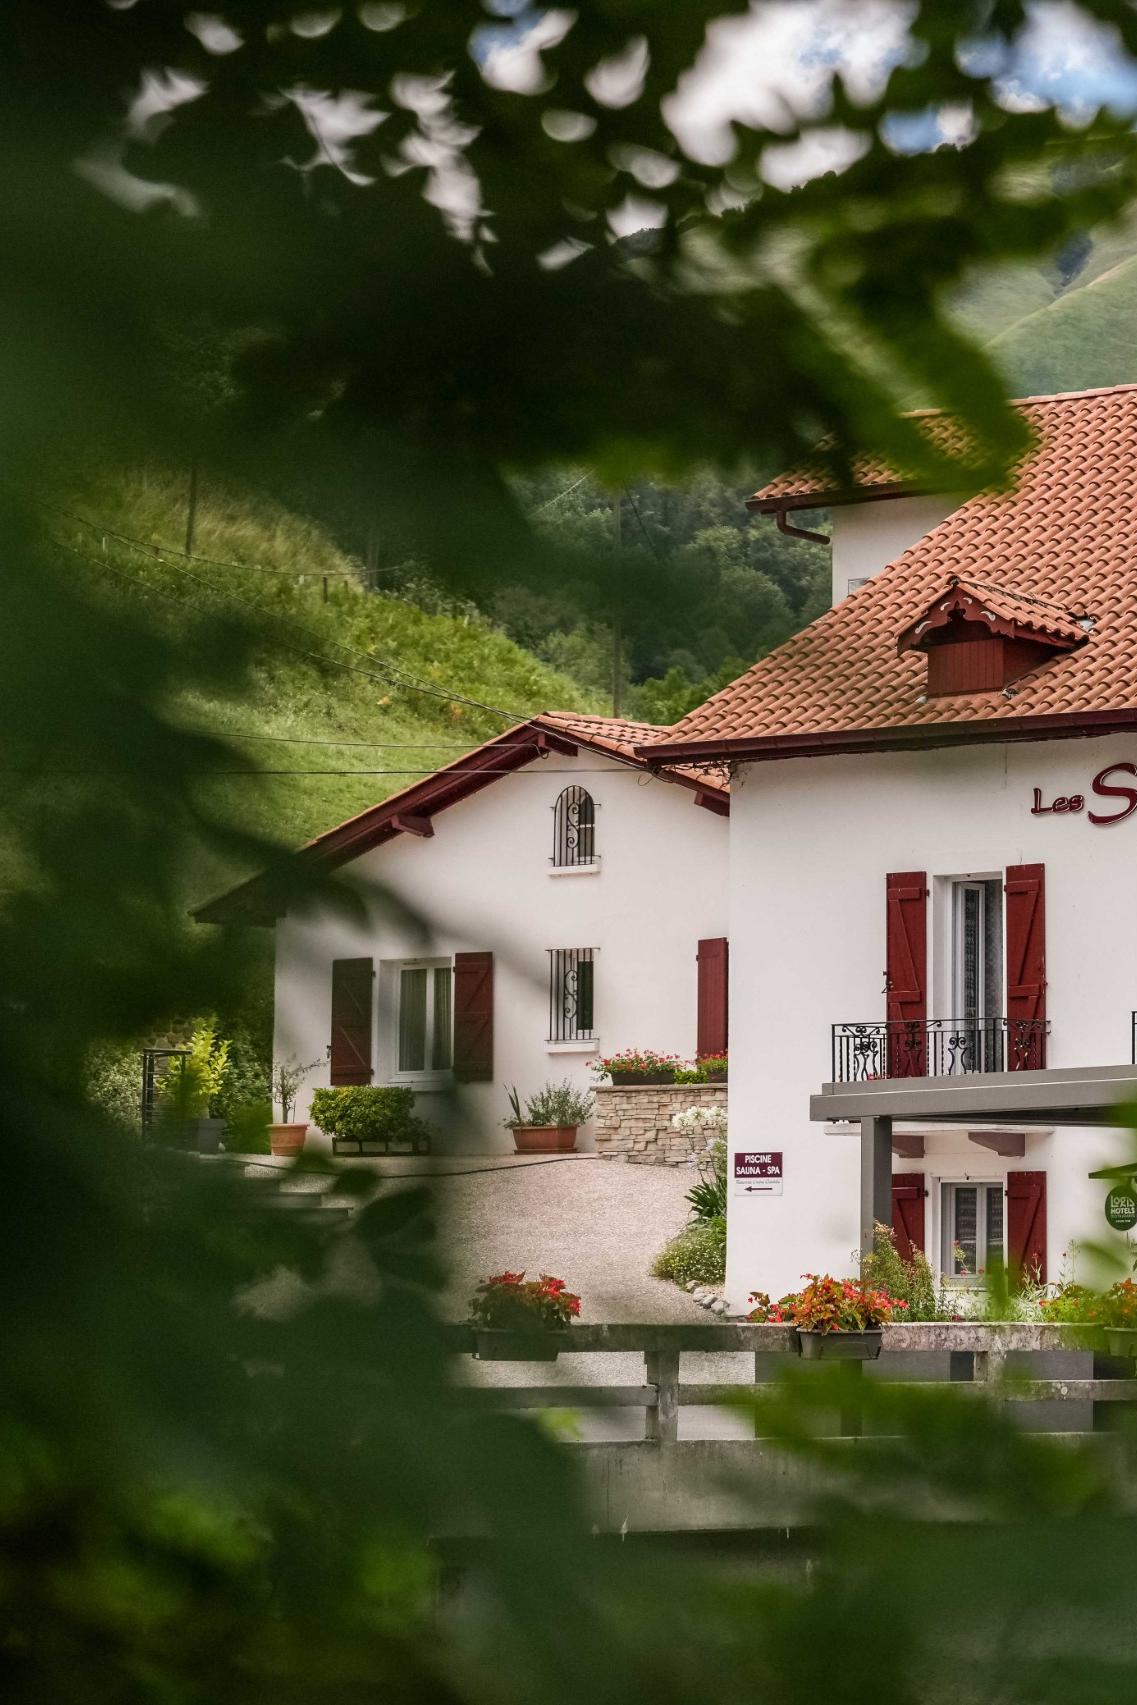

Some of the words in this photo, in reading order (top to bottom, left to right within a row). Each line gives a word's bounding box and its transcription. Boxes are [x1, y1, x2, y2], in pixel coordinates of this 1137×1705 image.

[1030, 787, 1085, 816] Les
[744, 1154, 772, 1164] PISCINE
[736, 1166, 761, 1175] SAUNA
[766, 1165, 780, 1175] SPA
[1110, 1207, 1135, 1215] HOTELS
